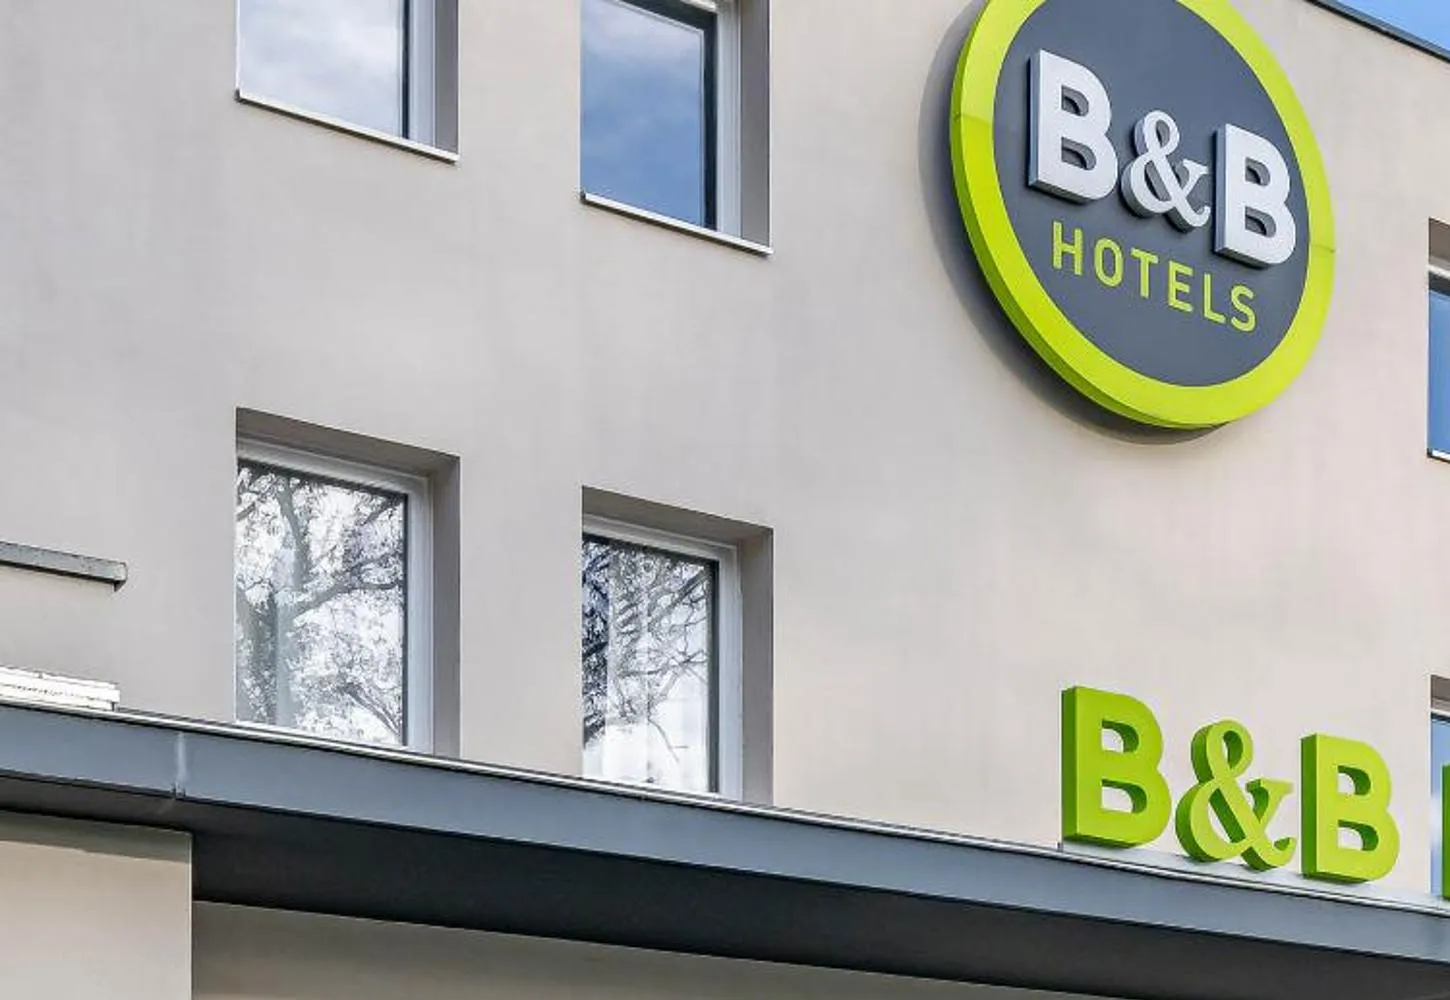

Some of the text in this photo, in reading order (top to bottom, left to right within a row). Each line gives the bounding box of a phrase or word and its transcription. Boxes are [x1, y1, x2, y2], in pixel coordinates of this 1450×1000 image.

[1029, 49, 1297, 268] B&B
[1052, 221, 1257, 333] HOTELS
[1061, 686, 1400, 884] B&B
